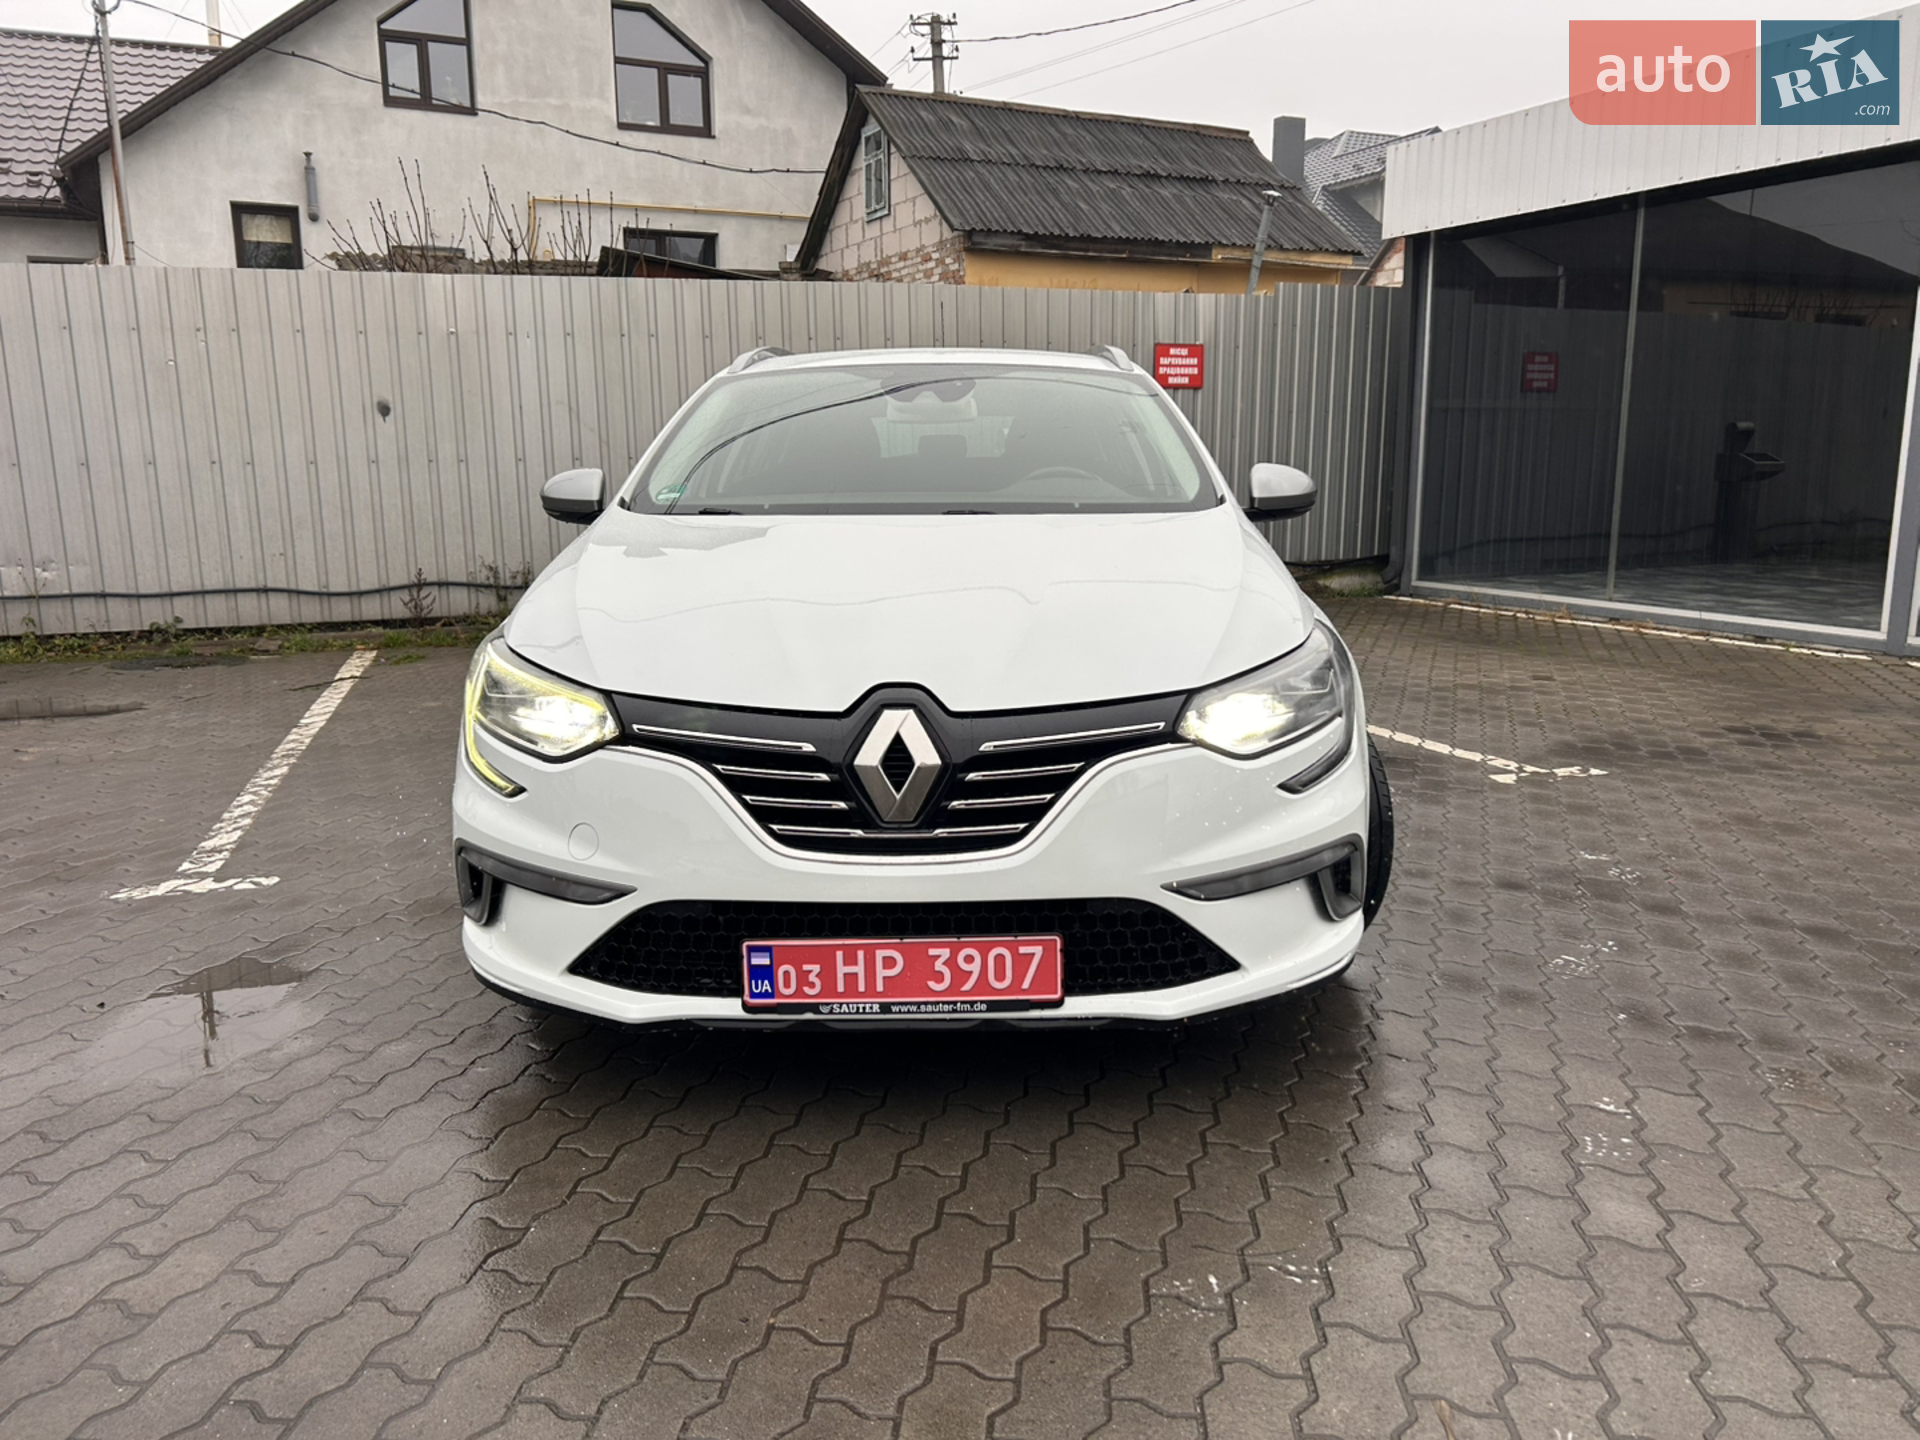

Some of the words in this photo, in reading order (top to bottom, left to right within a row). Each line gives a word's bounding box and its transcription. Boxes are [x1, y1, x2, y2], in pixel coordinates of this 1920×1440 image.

[777, 964, 822, 996] 03
[836, 949, 904, 993] HP
[927, 946, 1043, 992] 3907
[751, 980, 772, 993] UA
[832, 1003, 881, 1014] SAUTER
[890, 1002, 987, 1013] www.sauter-fm.de
